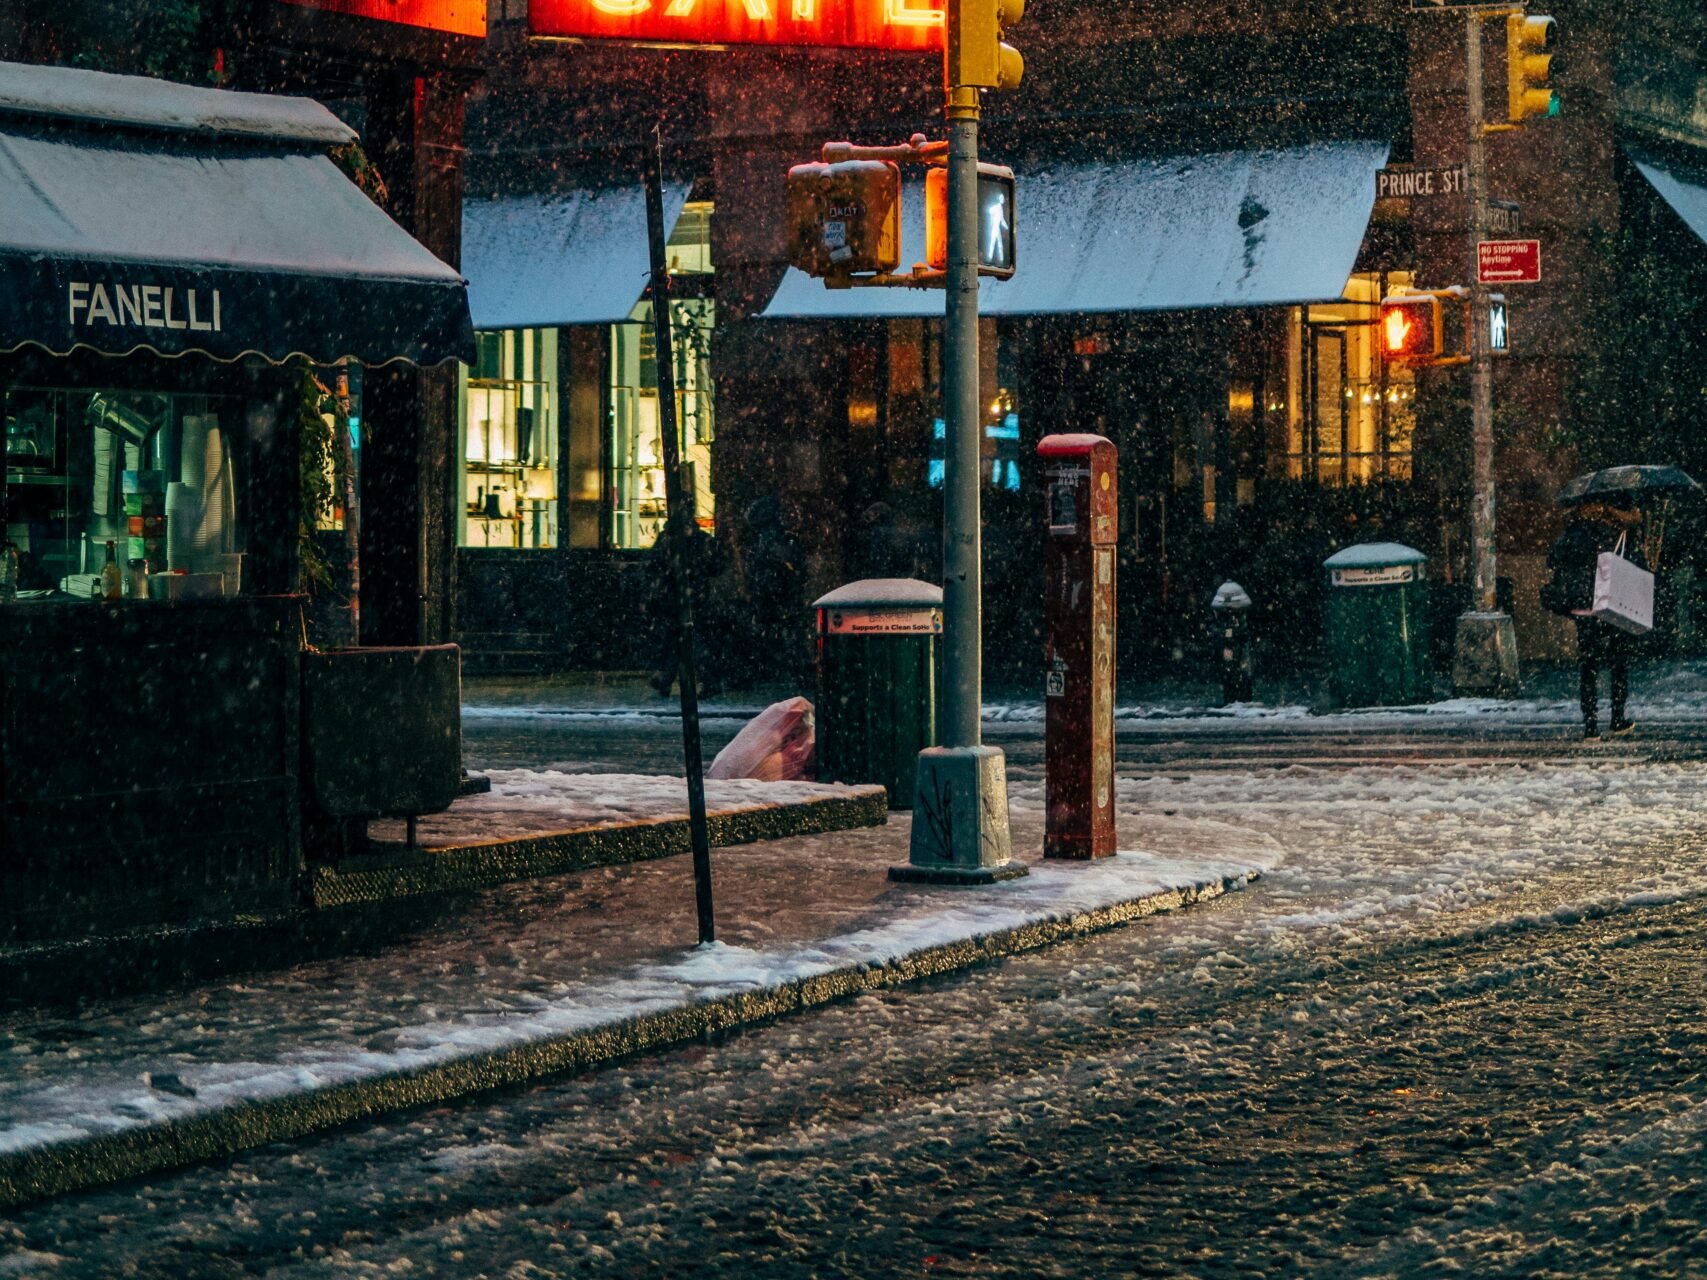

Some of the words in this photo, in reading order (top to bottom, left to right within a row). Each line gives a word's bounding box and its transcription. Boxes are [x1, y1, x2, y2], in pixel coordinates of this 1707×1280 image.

[1379, 171, 1434, 197] PRINCE
[1443, 169, 1461, 193] ST
[1481, 245, 1492, 255] NO
[1493, 244, 1529, 254] STOPPING
[1481, 255, 1512, 264] Anytime
[69, 282, 221, 331] FANELLI
